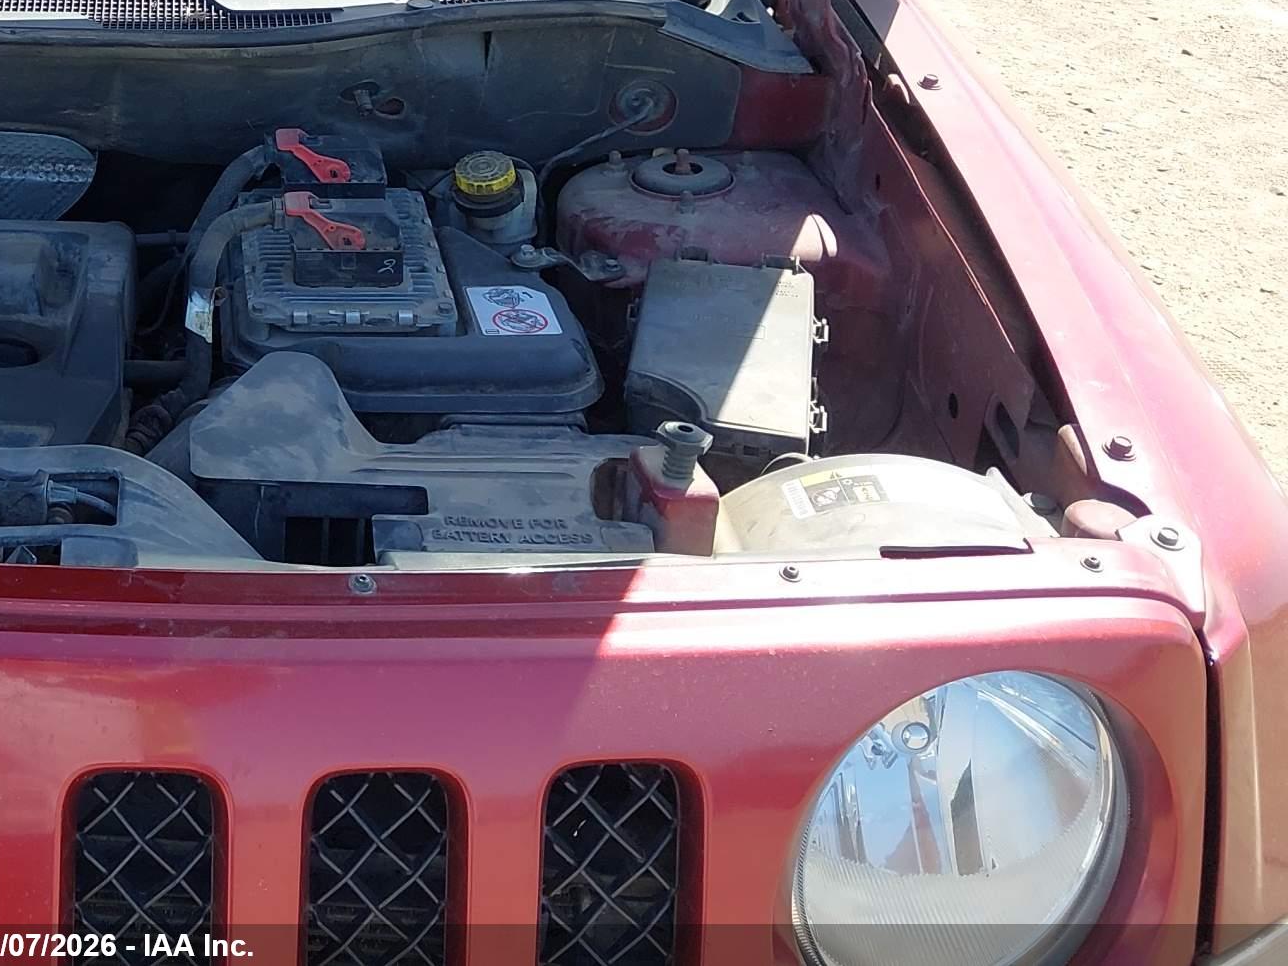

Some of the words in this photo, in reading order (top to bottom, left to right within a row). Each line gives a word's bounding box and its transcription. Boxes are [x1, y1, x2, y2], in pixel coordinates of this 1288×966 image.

[444, 515, 523, 530] REMOVE
[529, 518, 568, 530] FOR
[432, 529, 510, 544] BATTERY
[518, 533, 594, 545] ACCESS
